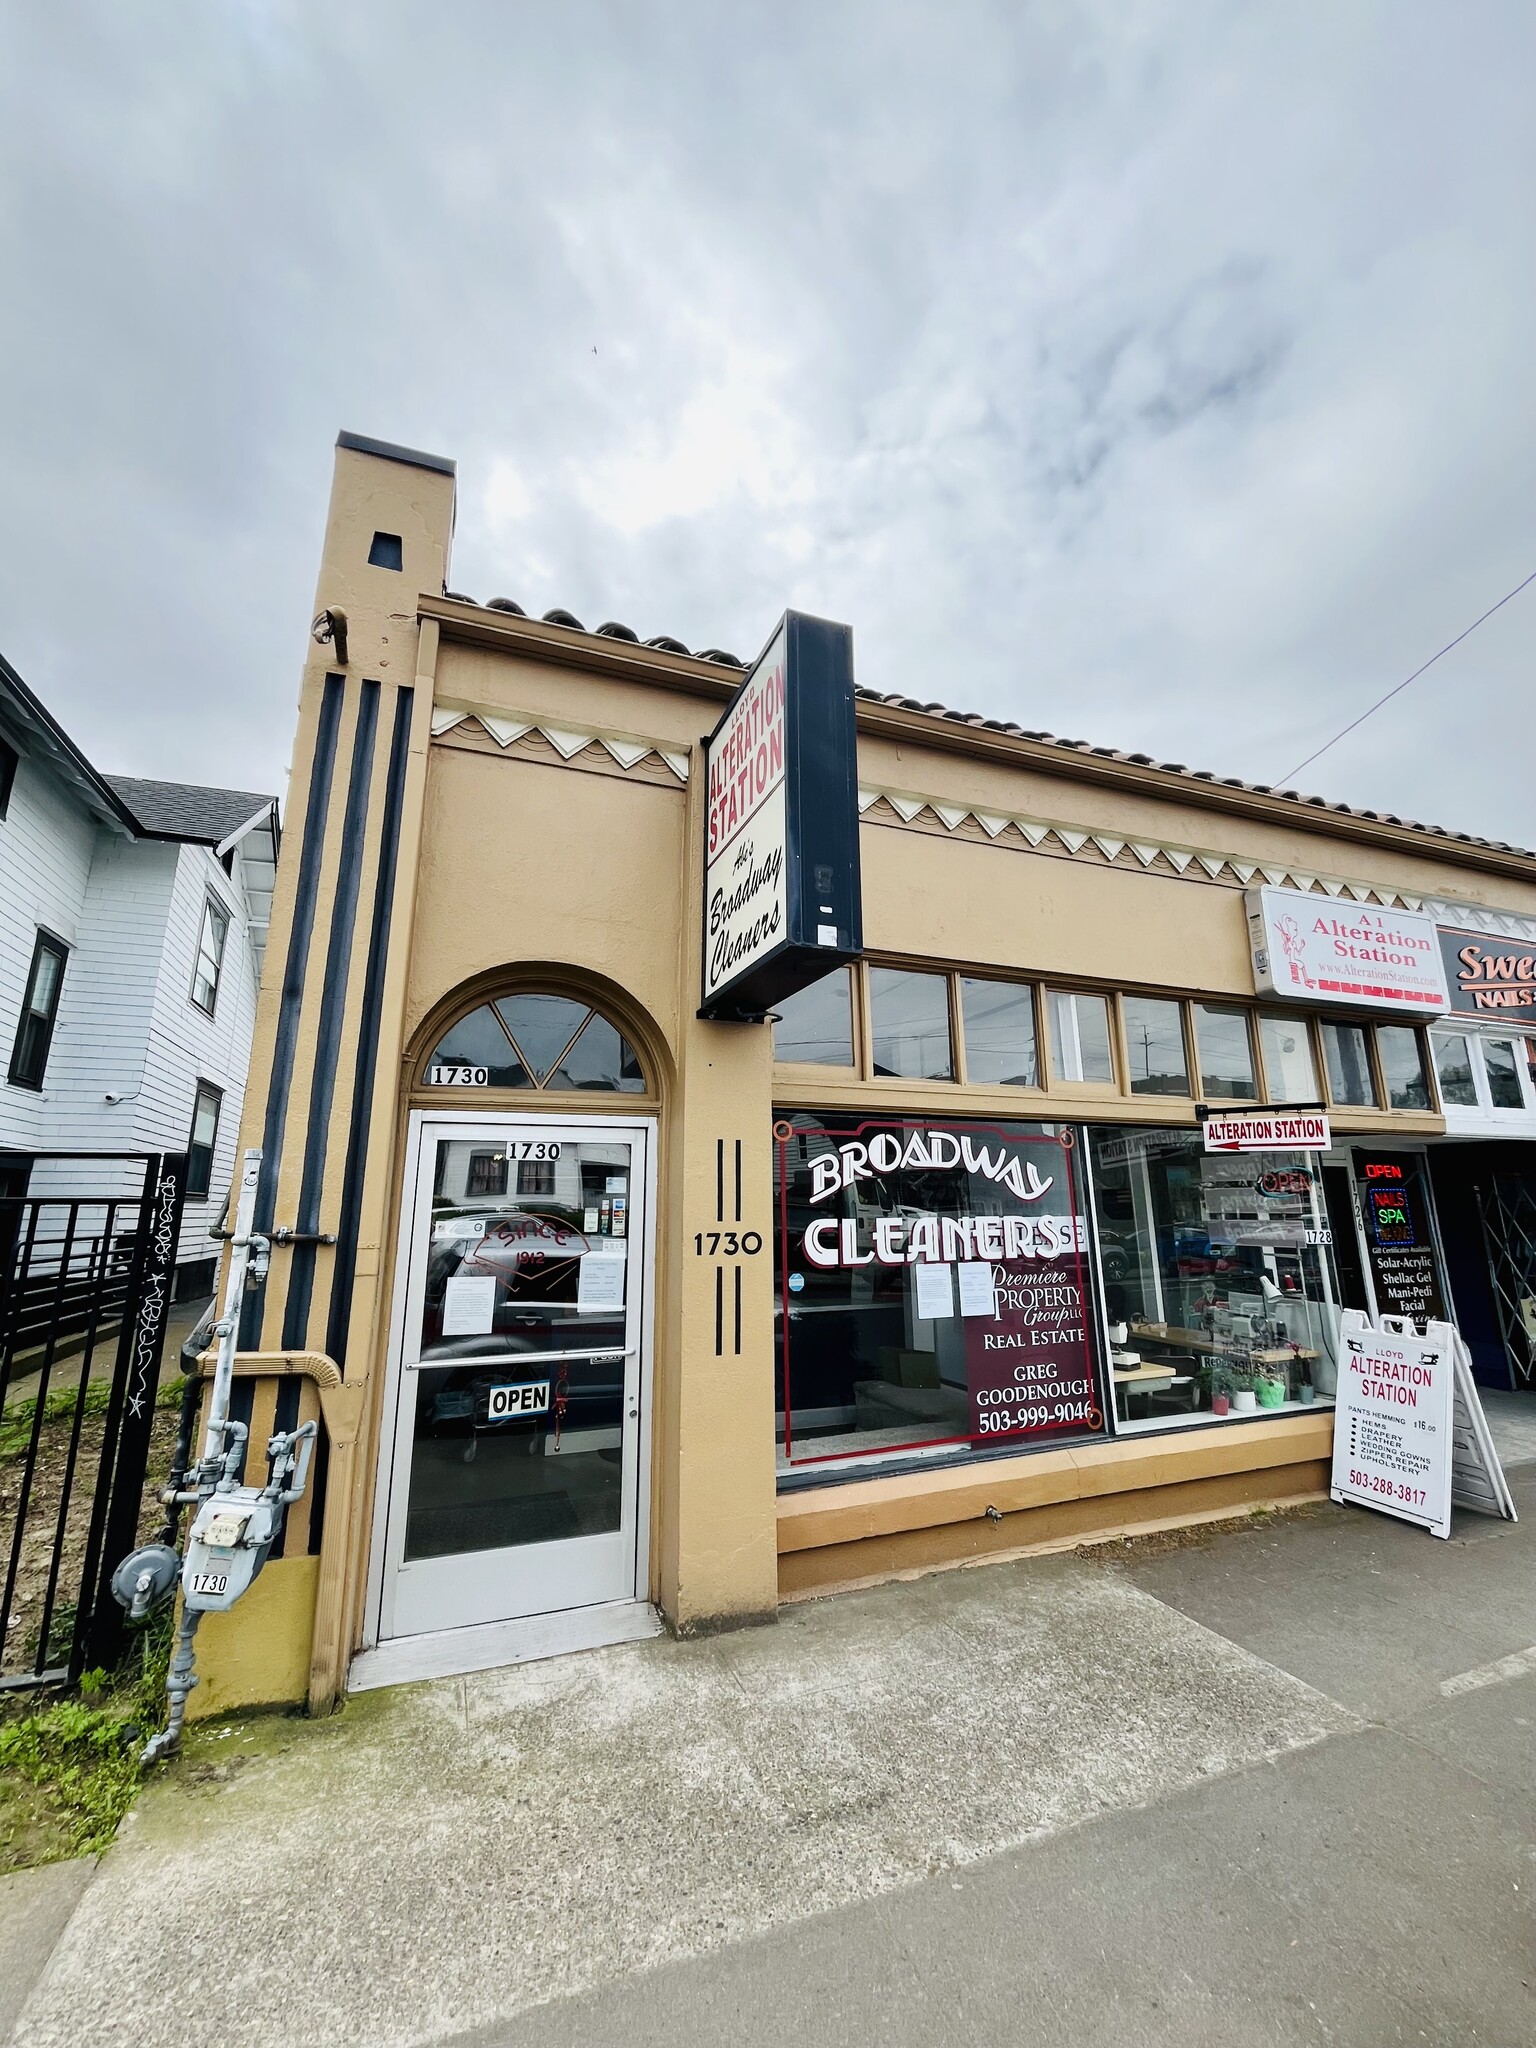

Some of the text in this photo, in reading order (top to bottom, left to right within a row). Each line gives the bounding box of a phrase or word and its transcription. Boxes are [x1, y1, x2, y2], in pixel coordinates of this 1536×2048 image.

[731, 686, 756, 730] LLOYD
[710, 662, 786, 808] ALTERATION
[709, 718, 782, 853] STATION
[710, 844, 783, 936] Broadway
[1359, 914, 1372, 926] A
[710, 899, 782, 988] Cleaners
[1312, 917, 1432, 951] Alteration
[1333, 939, 1417, 967] Station
[1457, 945, 1536, 981] Swe
[1318, 963, 1439, 987] www.AlterationStation.com
[1474, 989, 1533, 1009] NAILS
[434, 1068, 488, 1085] 1730
[1208, 1119, 1325, 1140] ALTERATION STATION
[508, 1142, 561, 1160] 1730
[807, 1130, 1054, 1204] BROADWAY
[1365, 1164, 1402, 1178] OPEN
[1263, 1170, 1312, 1192] OPEN
[1351, 1180, 1363, 1231] 1726
[1374, 1192, 1405, 1207] NAILS
[1378, 1208, 1406, 1224] SPA
[694, 1231, 763, 1256] 1730
[803, 1215, 1062, 1267] CLEANERS
[1307, 1231, 1332, 1243] 1728
[516, 1251, 546, 1265] 1912
[1377, 1256, 1432, 1271] Solar-Acrylic
[990, 1262, 1068, 1287] Premiere
[1382, 1271, 1432, 1285] Shellac Gel
[992, 1286, 1081, 1321] PROPERTY
[1388, 1285, 1433, 1299] Mani-Pedi
[1400, 1299, 1426, 1312] Facial
[983, 1328, 1085, 1350] REAL ESTATE
[1375, 1348, 1404, 1360] LLOYD
[1013, 1363, 1058, 1381] GREG
[1350, 1355, 1432, 1387] ALTERATION
[493, 1386, 547, 1414] OPEN
[976, 1378, 1095, 1406] GOODENOUGH
[1362, 1379, 1417, 1407] STATION
[979, 1400, 1094, 1434] 503-999-9046
[1348, 1405, 1371, 1416] PANTS
[1372, 1412, 1406, 1425] HEMMING
[1362, 1419, 1387, 1430] HEMS
[1361, 1426, 1403, 1441] DRAPERY
[1361, 1433, 1402, 1449] LEATHER
[1360, 1440, 1431, 1465] WEDDING GOWNS
[1360, 1447, 1430, 1472] ZIPPER REPAIR
[1360, 1454, 1420, 1477] UPHOLSTERY
[1349, 1469, 1427, 1506] 503-288-3817
[193, 1574, 228, 1592] 1730
